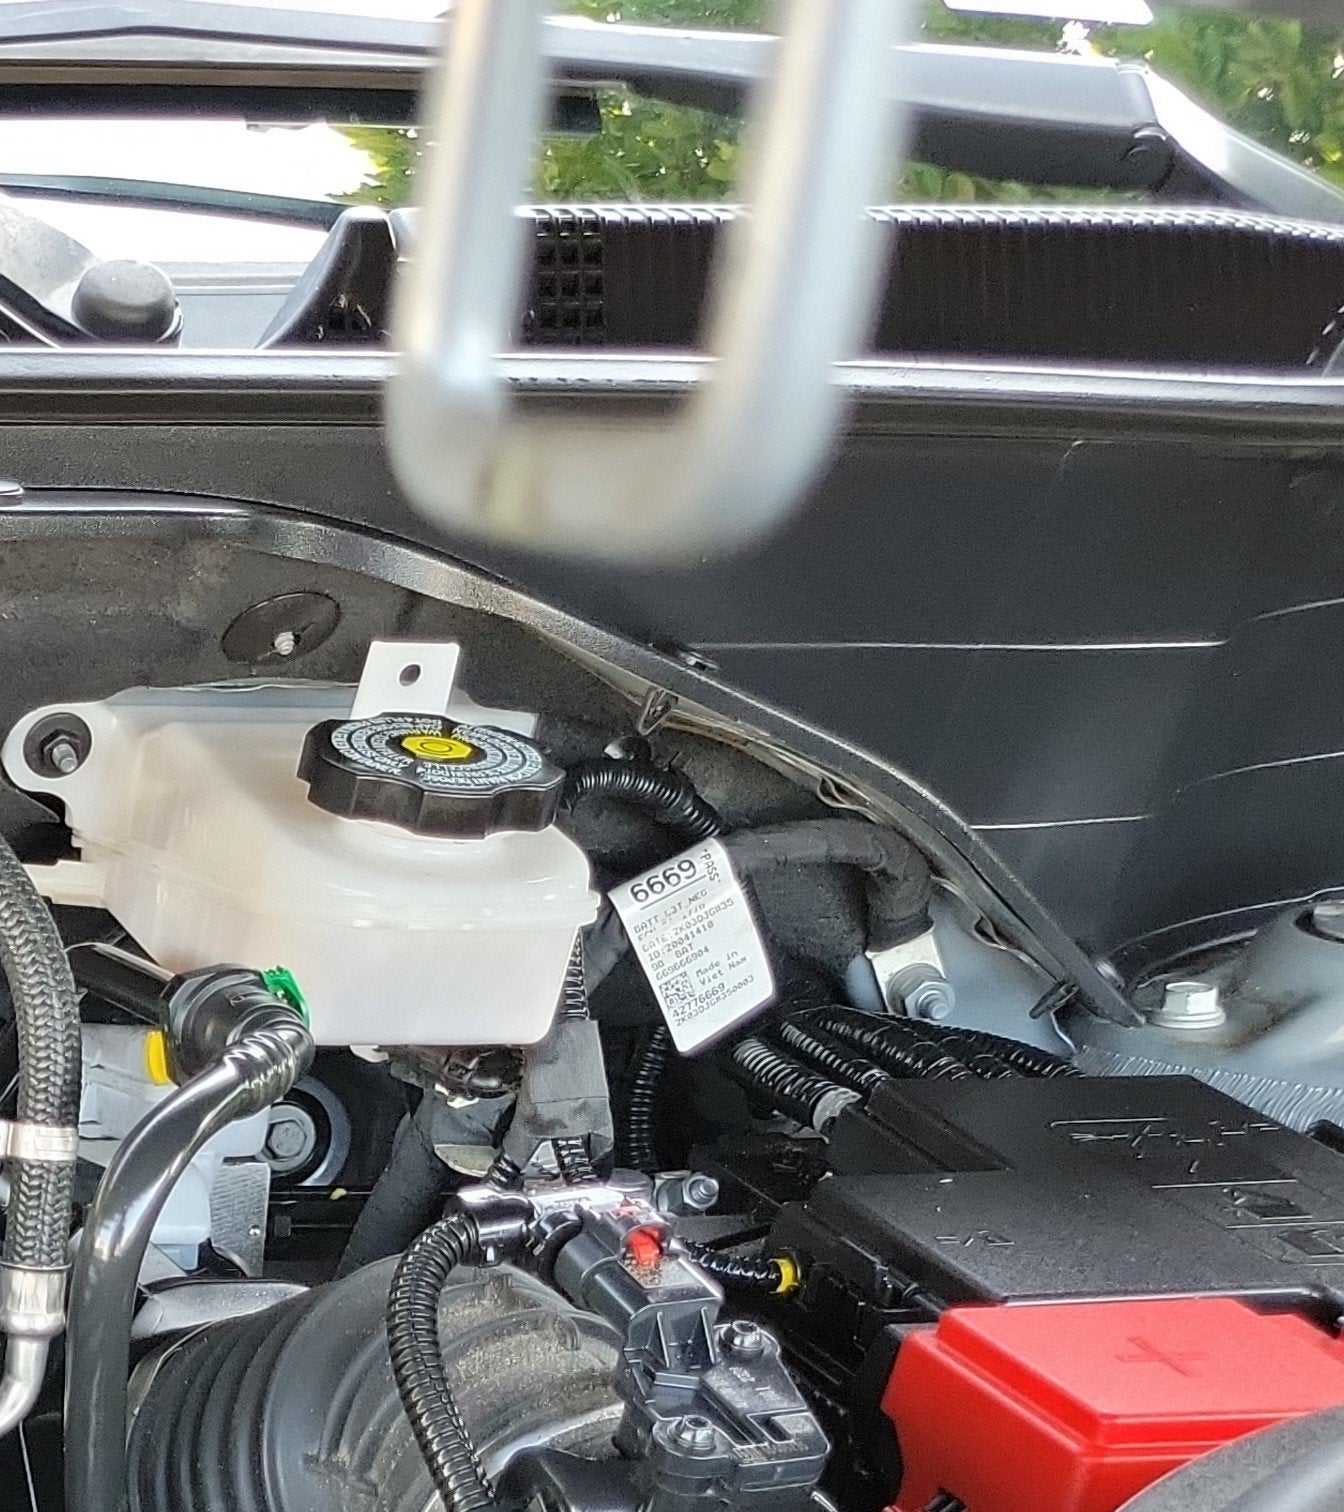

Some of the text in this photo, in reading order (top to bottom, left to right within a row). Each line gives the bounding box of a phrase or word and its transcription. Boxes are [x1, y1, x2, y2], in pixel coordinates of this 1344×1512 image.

[630, 859, 698, 903] 6669
[694, 949, 739, 979] Made in
[699, 956, 748, 987] Viet Nam
[670, 982, 727, 1019] 42776669
